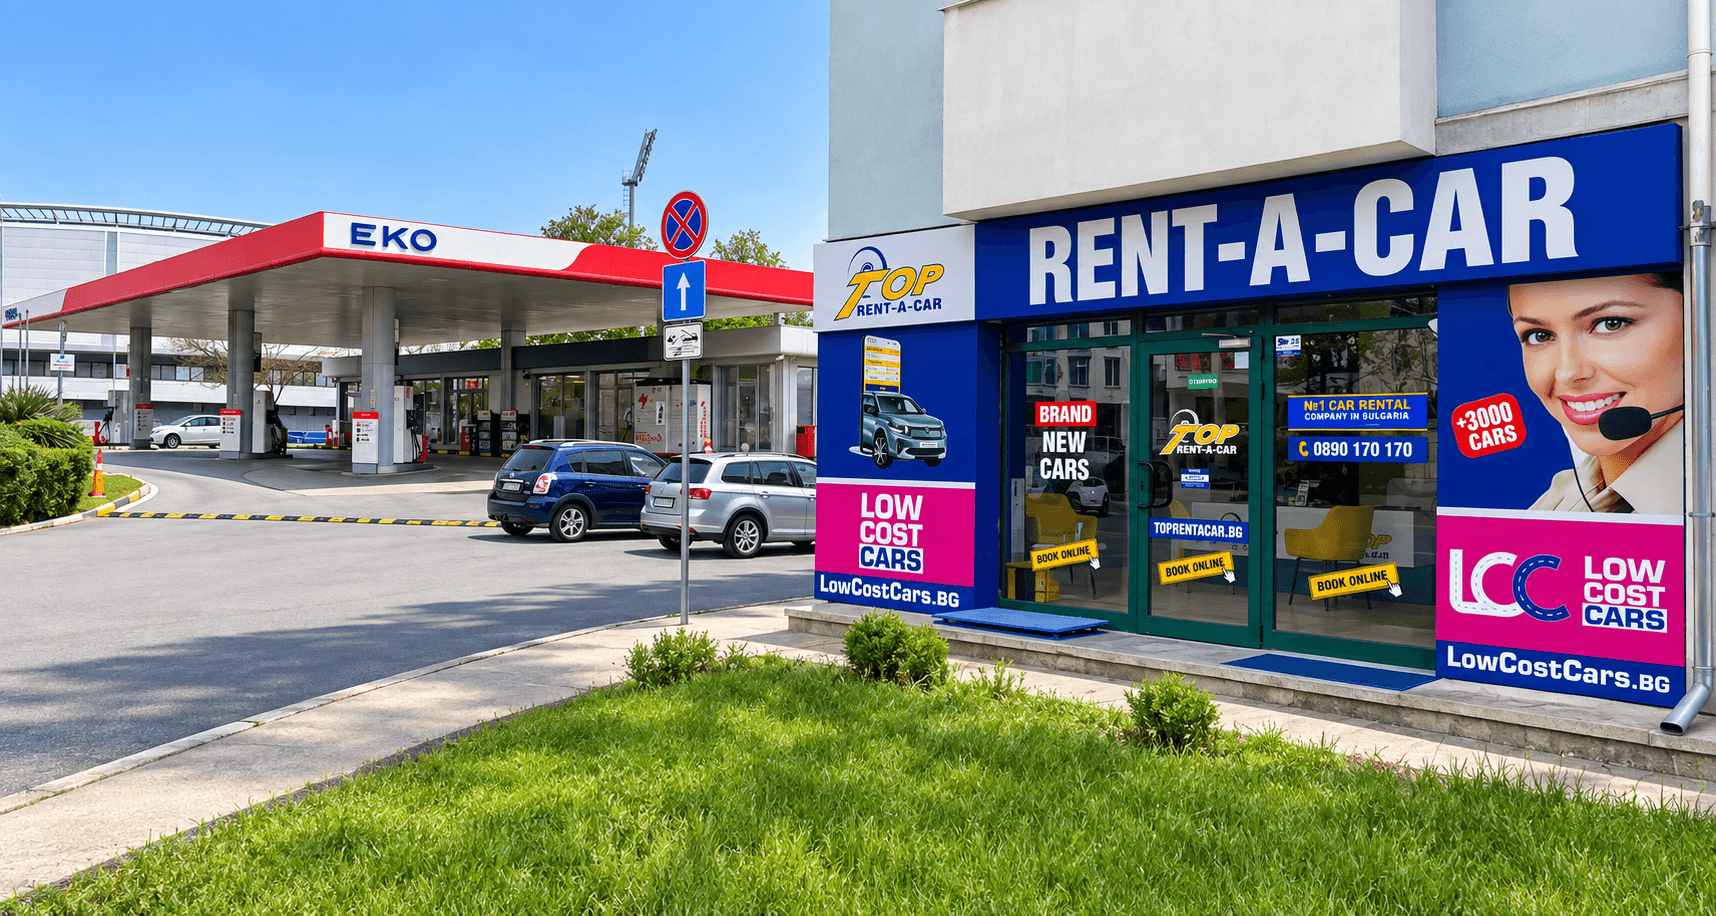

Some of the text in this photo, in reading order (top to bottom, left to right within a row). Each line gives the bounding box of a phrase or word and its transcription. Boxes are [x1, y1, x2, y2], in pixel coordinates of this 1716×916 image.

[351, 222, 437, 252] EKO
[1029, 156, 1579, 306] RENT-A-CAR
[834, 263, 945, 321] TOP
[857, 298, 942, 317] RENT-A-CAR
[1039, 405, 1092, 423] BRAND
[1304, 411, 1410, 421] COMPANY IN BULGARIA
[1329, 400, 1354, 411] CAR
[1359, 398, 1411, 411] RENTAL
[1456, 401, 1514, 431] +3000
[1042, 431, 1087, 454] NEW
[1159, 424, 1240, 455] TOP
[1176, 445, 1237, 455] RENT-A-CAR
[1313, 441, 1413, 457] 0890 170 170
[1469, 424, 1518, 451] CARS
[1040, 458, 1090, 480] CARS
[861, 492, 924, 521] LOW
[860, 520, 923, 547] COST
[1153, 522, 1243, 539] TOPRENTACAR.BG
[860, 546, 922, 572] CARS
[1036, 553, 1059, 564] BOOK
[1165, 557, 1226, 577] BOOK ONLINE
[1584, 556, 1665, 584] LOW
[820, 574, 960, 608] LowCostCars.BG
[1317, 569, 1388, 592] BOOK ONLINE
[1450, 549, 1571, 622] LCC
[1583, 582, 1665, 607] COST
[1584, 606, 1666, 631] CARS
[1447, 646, 1670, 693] LowCostCars.BG
